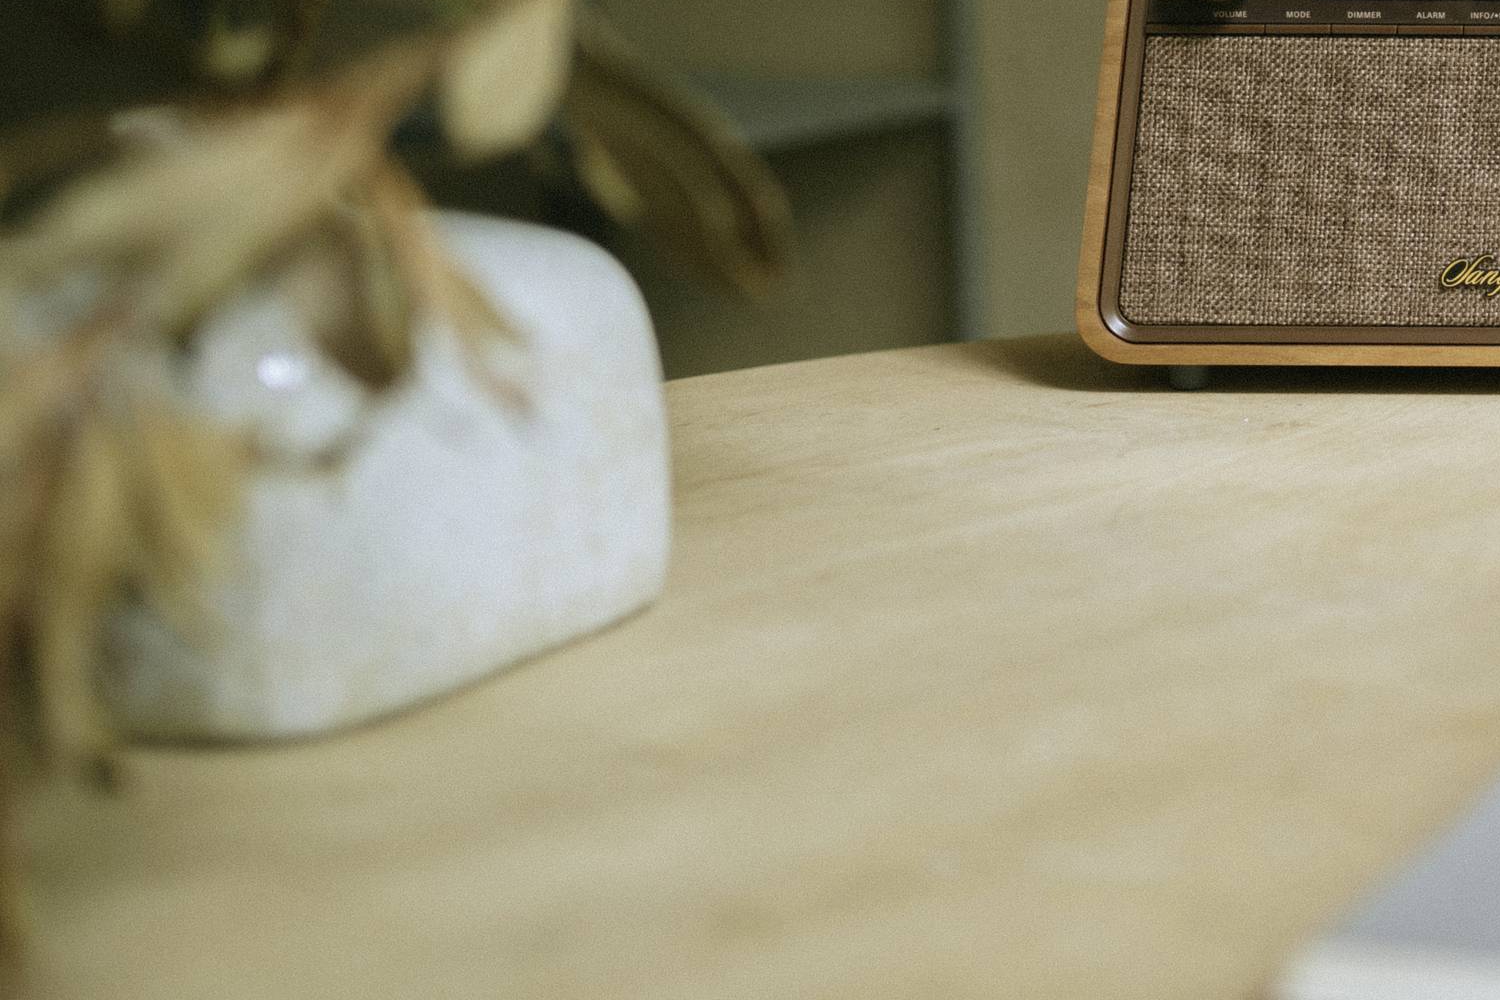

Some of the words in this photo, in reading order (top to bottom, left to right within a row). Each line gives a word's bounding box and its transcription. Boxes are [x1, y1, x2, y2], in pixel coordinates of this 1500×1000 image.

[1214, 10, 1248, 18] VOLUME
[1286, 10, 1311, 18] MODE
[1347, 11, 1382, 19] DIMMER
[1416, 11, 1446, 19] ALARM
